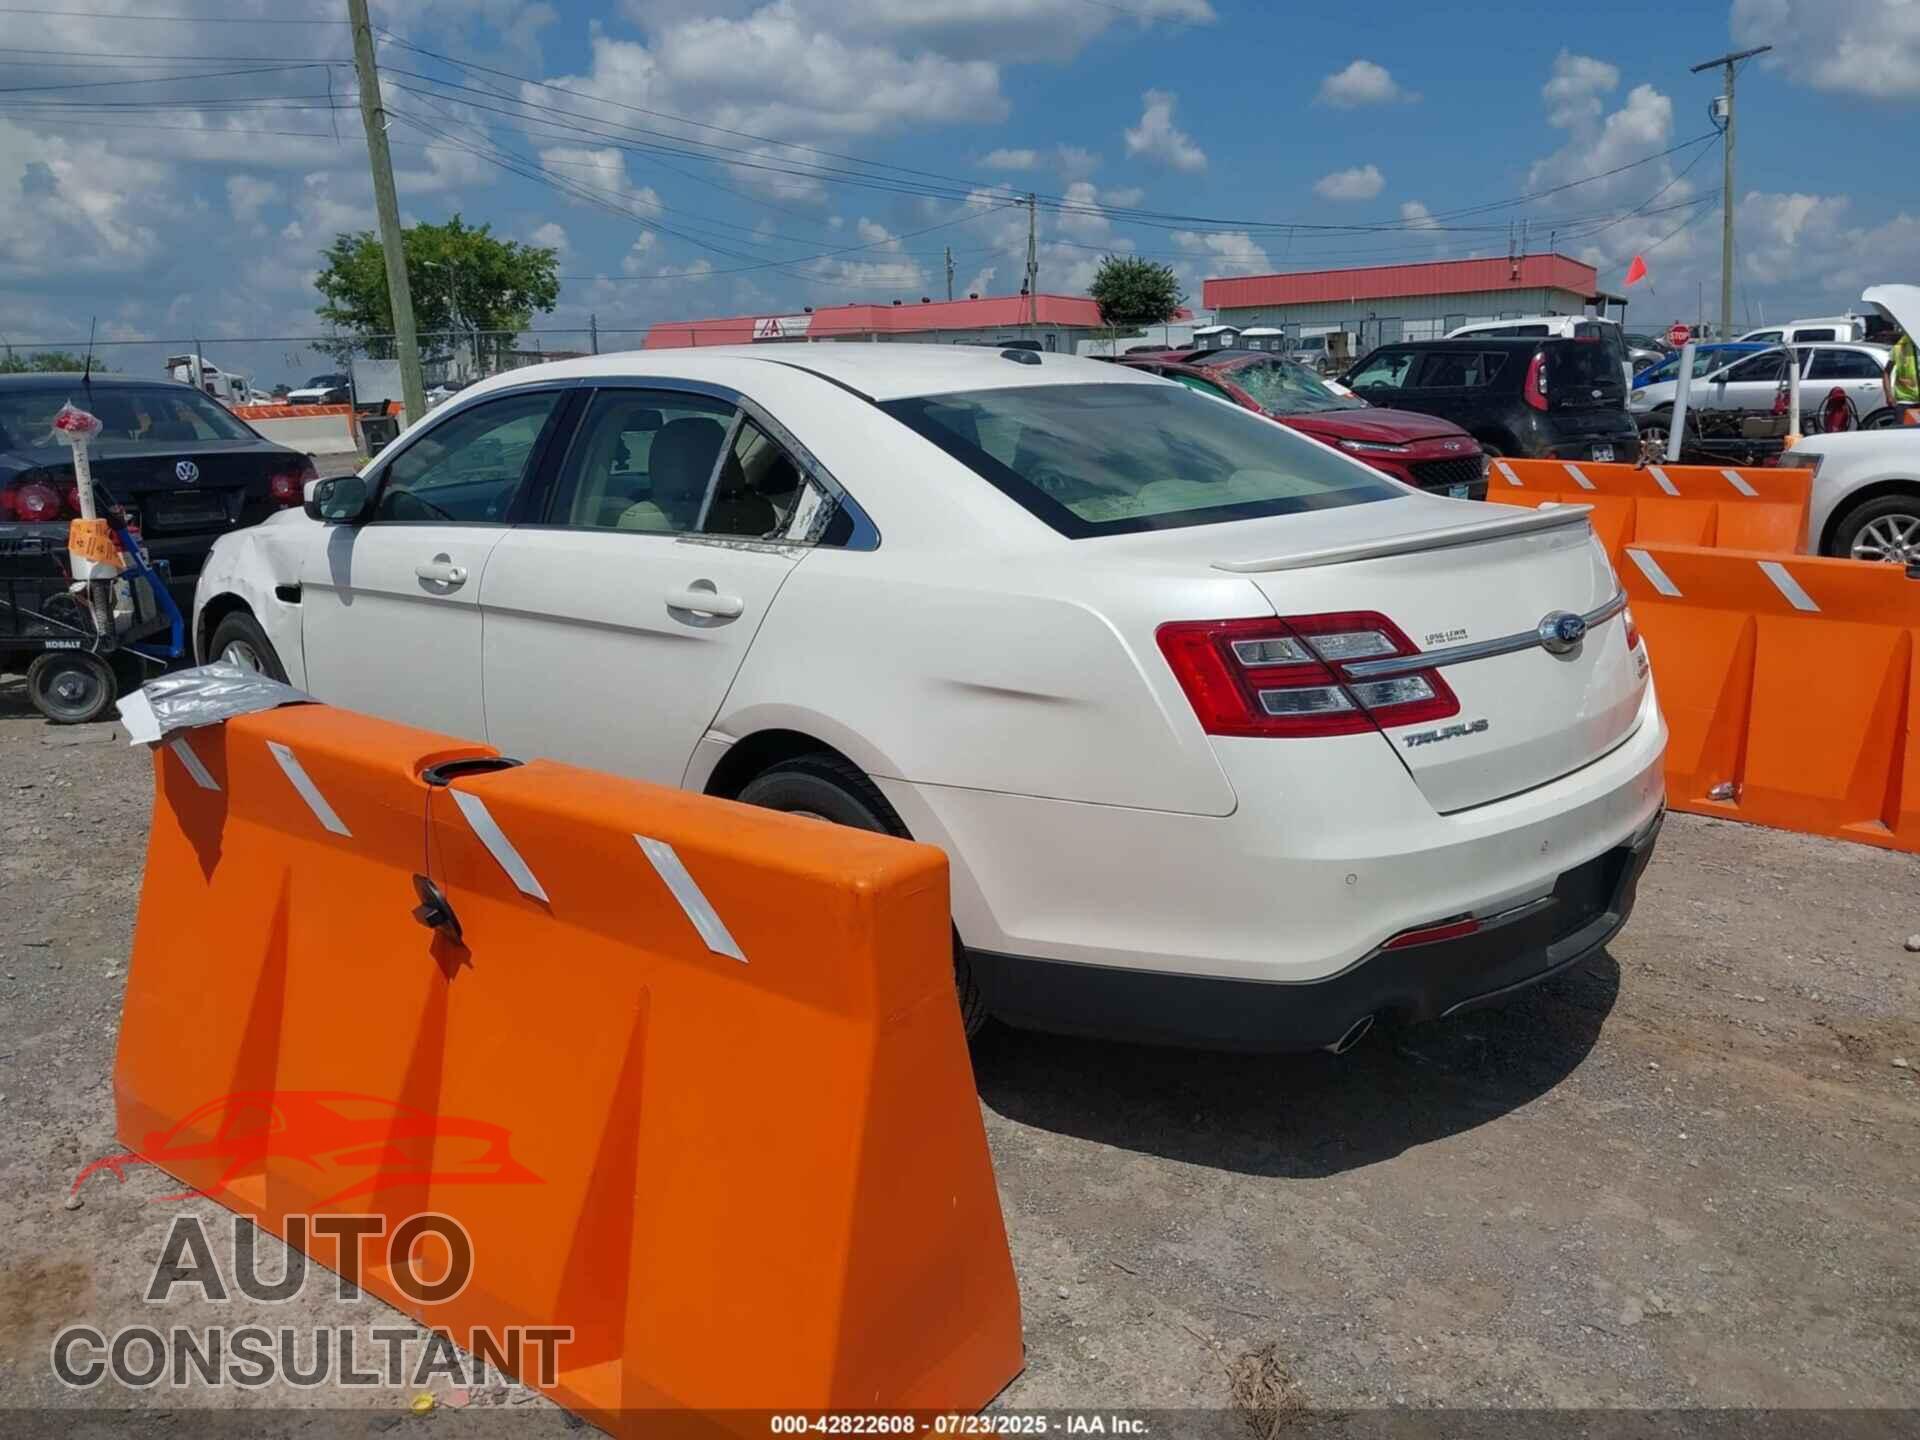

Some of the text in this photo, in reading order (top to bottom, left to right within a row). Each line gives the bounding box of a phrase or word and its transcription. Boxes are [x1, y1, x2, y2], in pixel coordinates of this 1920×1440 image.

[1669, 330, 1689, 341] STOP
[45, 639, 81, 649] KOBALT
[1403, 719, 1489, 748] TAURUS
